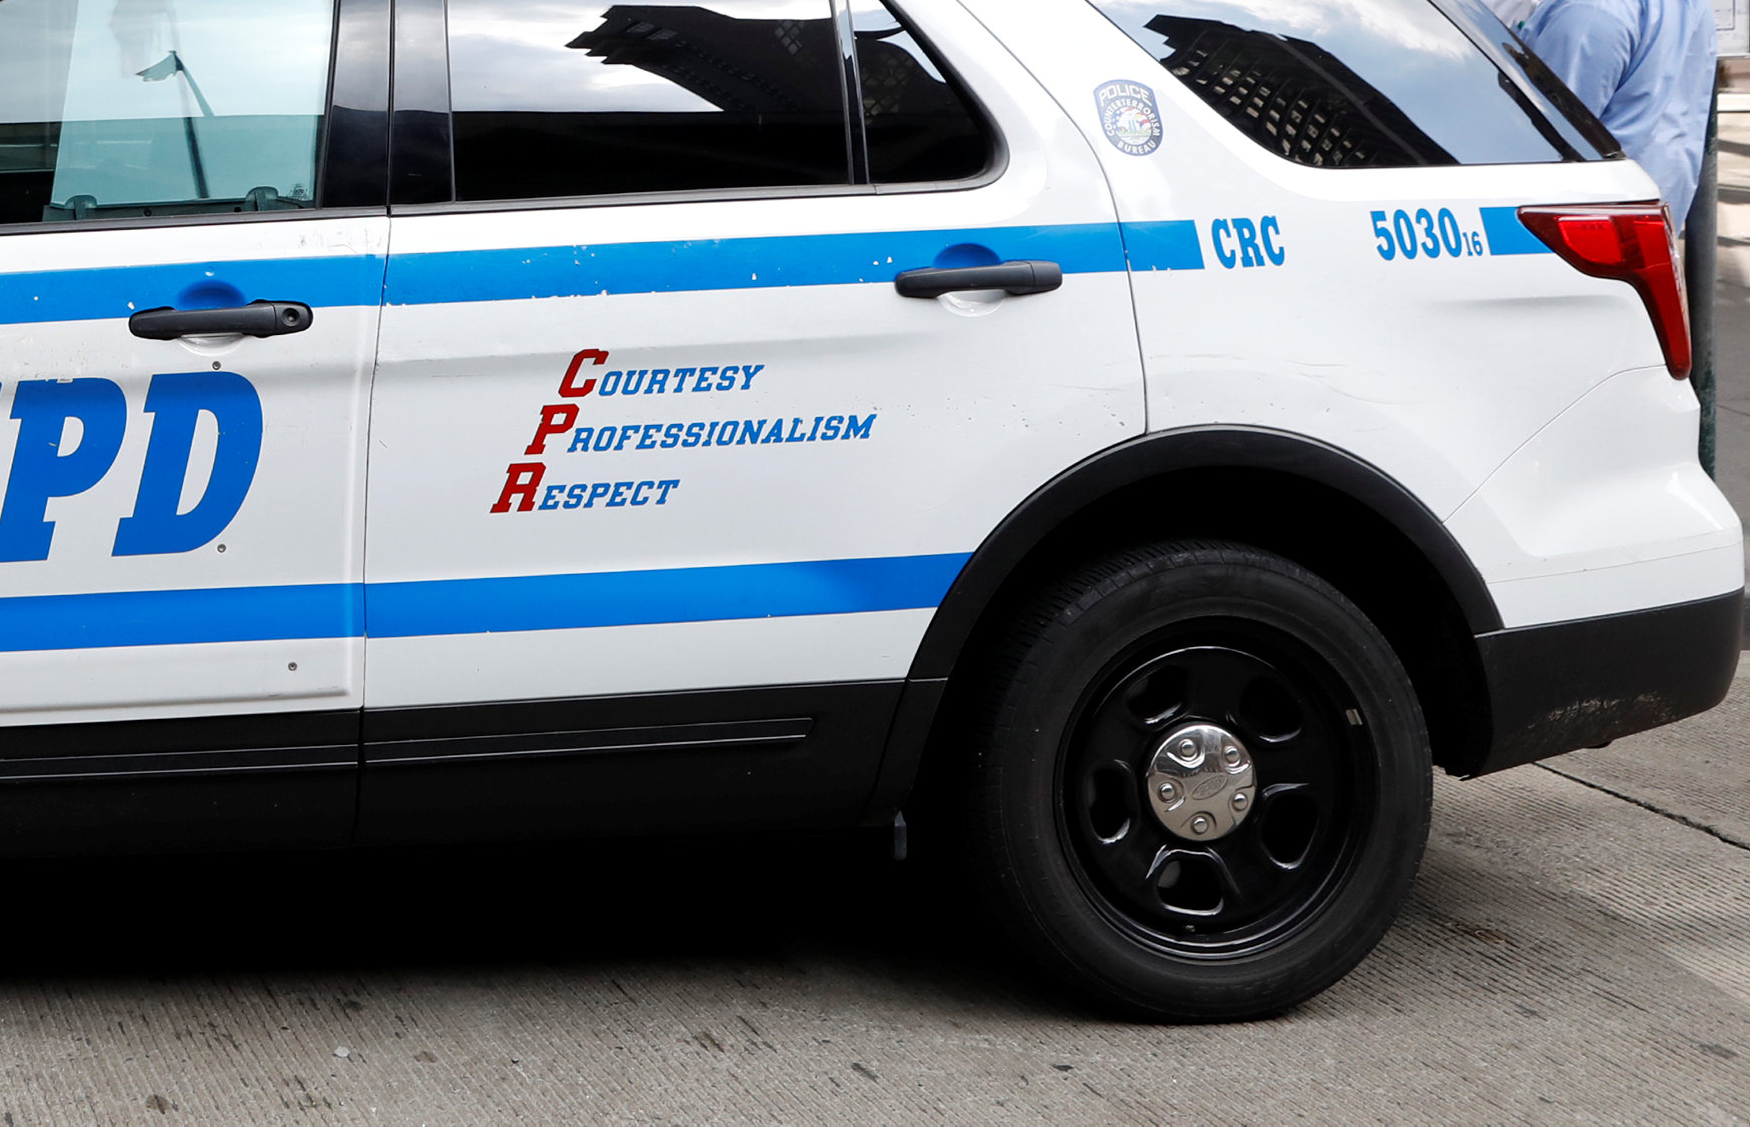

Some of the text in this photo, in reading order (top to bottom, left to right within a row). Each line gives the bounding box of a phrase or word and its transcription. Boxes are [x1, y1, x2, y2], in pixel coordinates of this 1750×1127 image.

[1098, 84, 1153, 107] POLICE
[1103, 98, 1161, 137] COUNTERTERRORISM
[1117, 139, 1156, 153] BUREAU
[1211, 215, 1285, 269] CRC
[1370, 207, 1463, 261] 5030
[558, 348, 765, 398] COURTESY
[524, 403, 877, 456] PROFESSIONALISM
[489, 462, 681, 513] RESPECT
